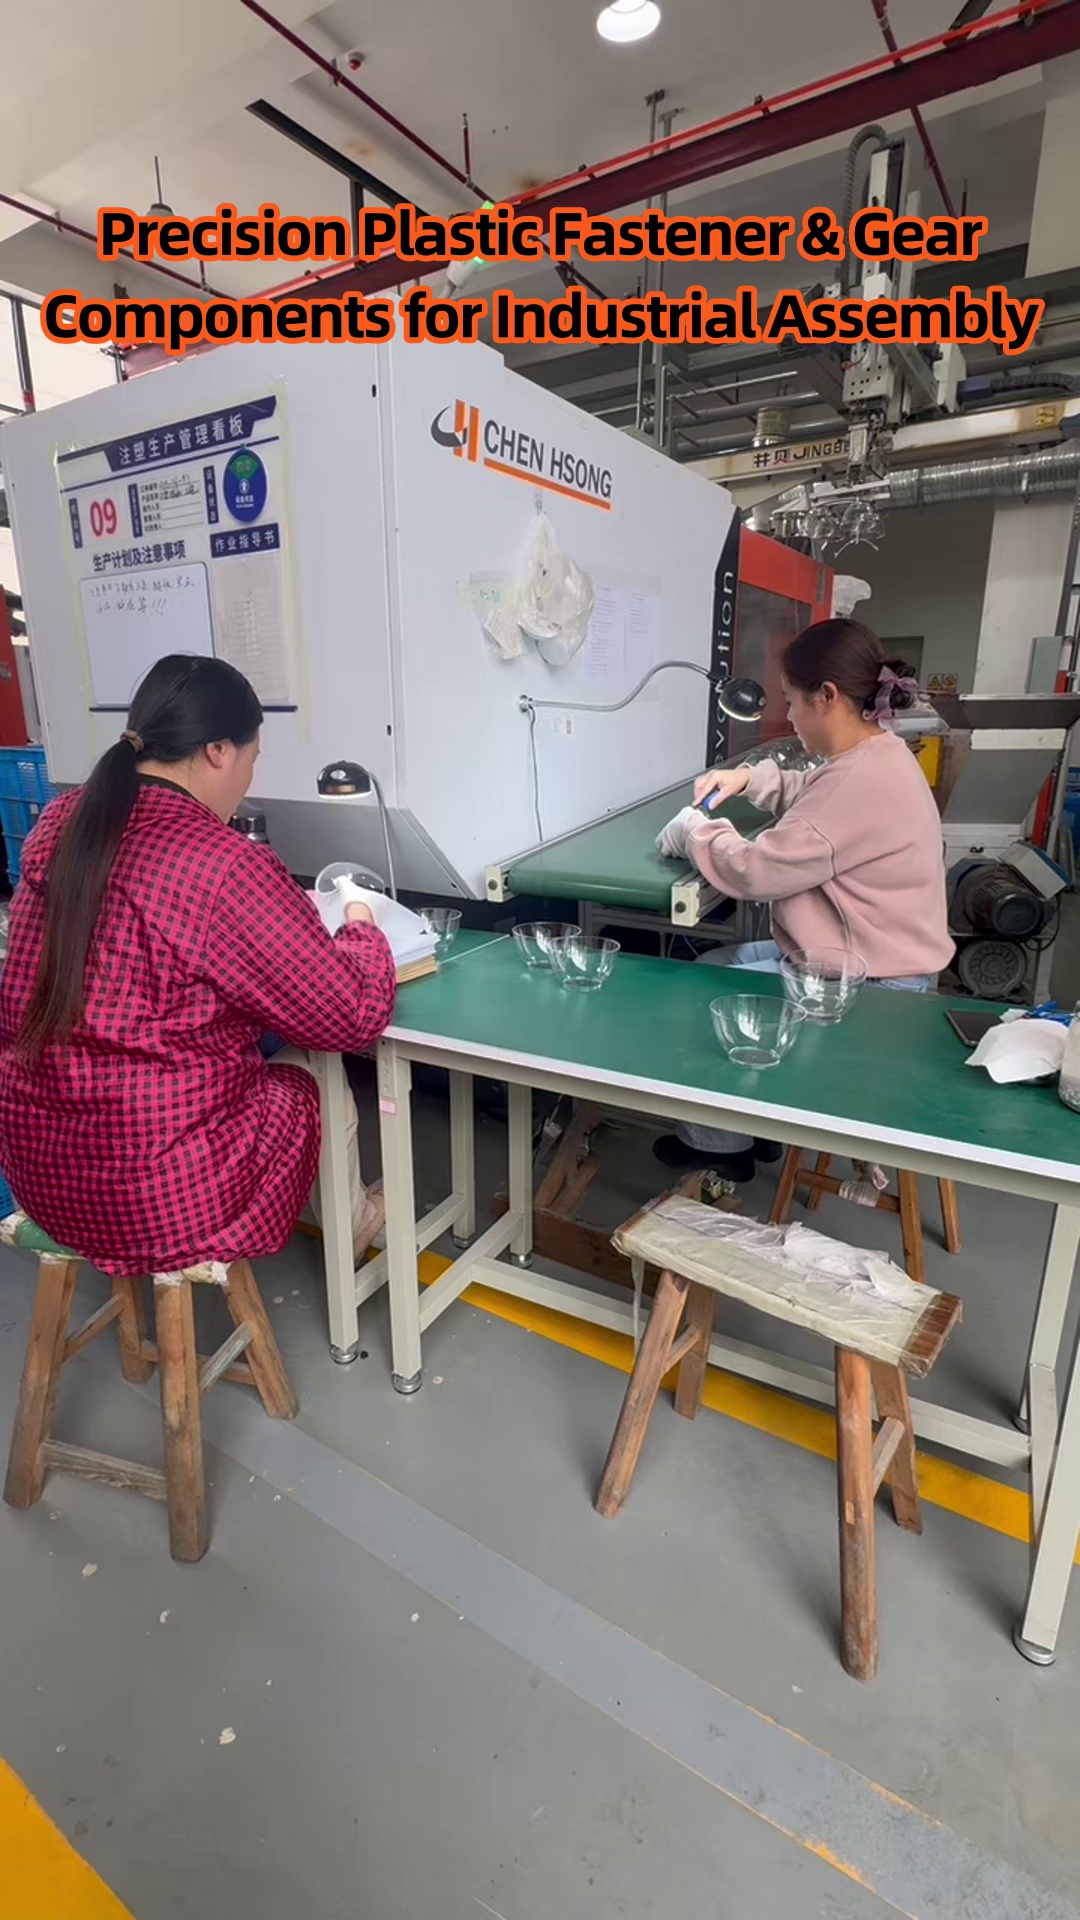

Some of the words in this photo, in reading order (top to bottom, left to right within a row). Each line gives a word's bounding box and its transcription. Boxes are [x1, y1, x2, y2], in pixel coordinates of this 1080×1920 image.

[119, 413, 244, 465] 注塑生产管理看板
[793, 441, 850, 460] JINGBE
[484, 419, 545, 473] CHEN
[550, 447, 612, 499] HSONG
[753, 449, 789, 468] 井贝
[90, 498, 117, 537] 09
[93, 540, 186, 572] 生产计划及注意事项
[215, 529, 275, 553] 作业指导书
